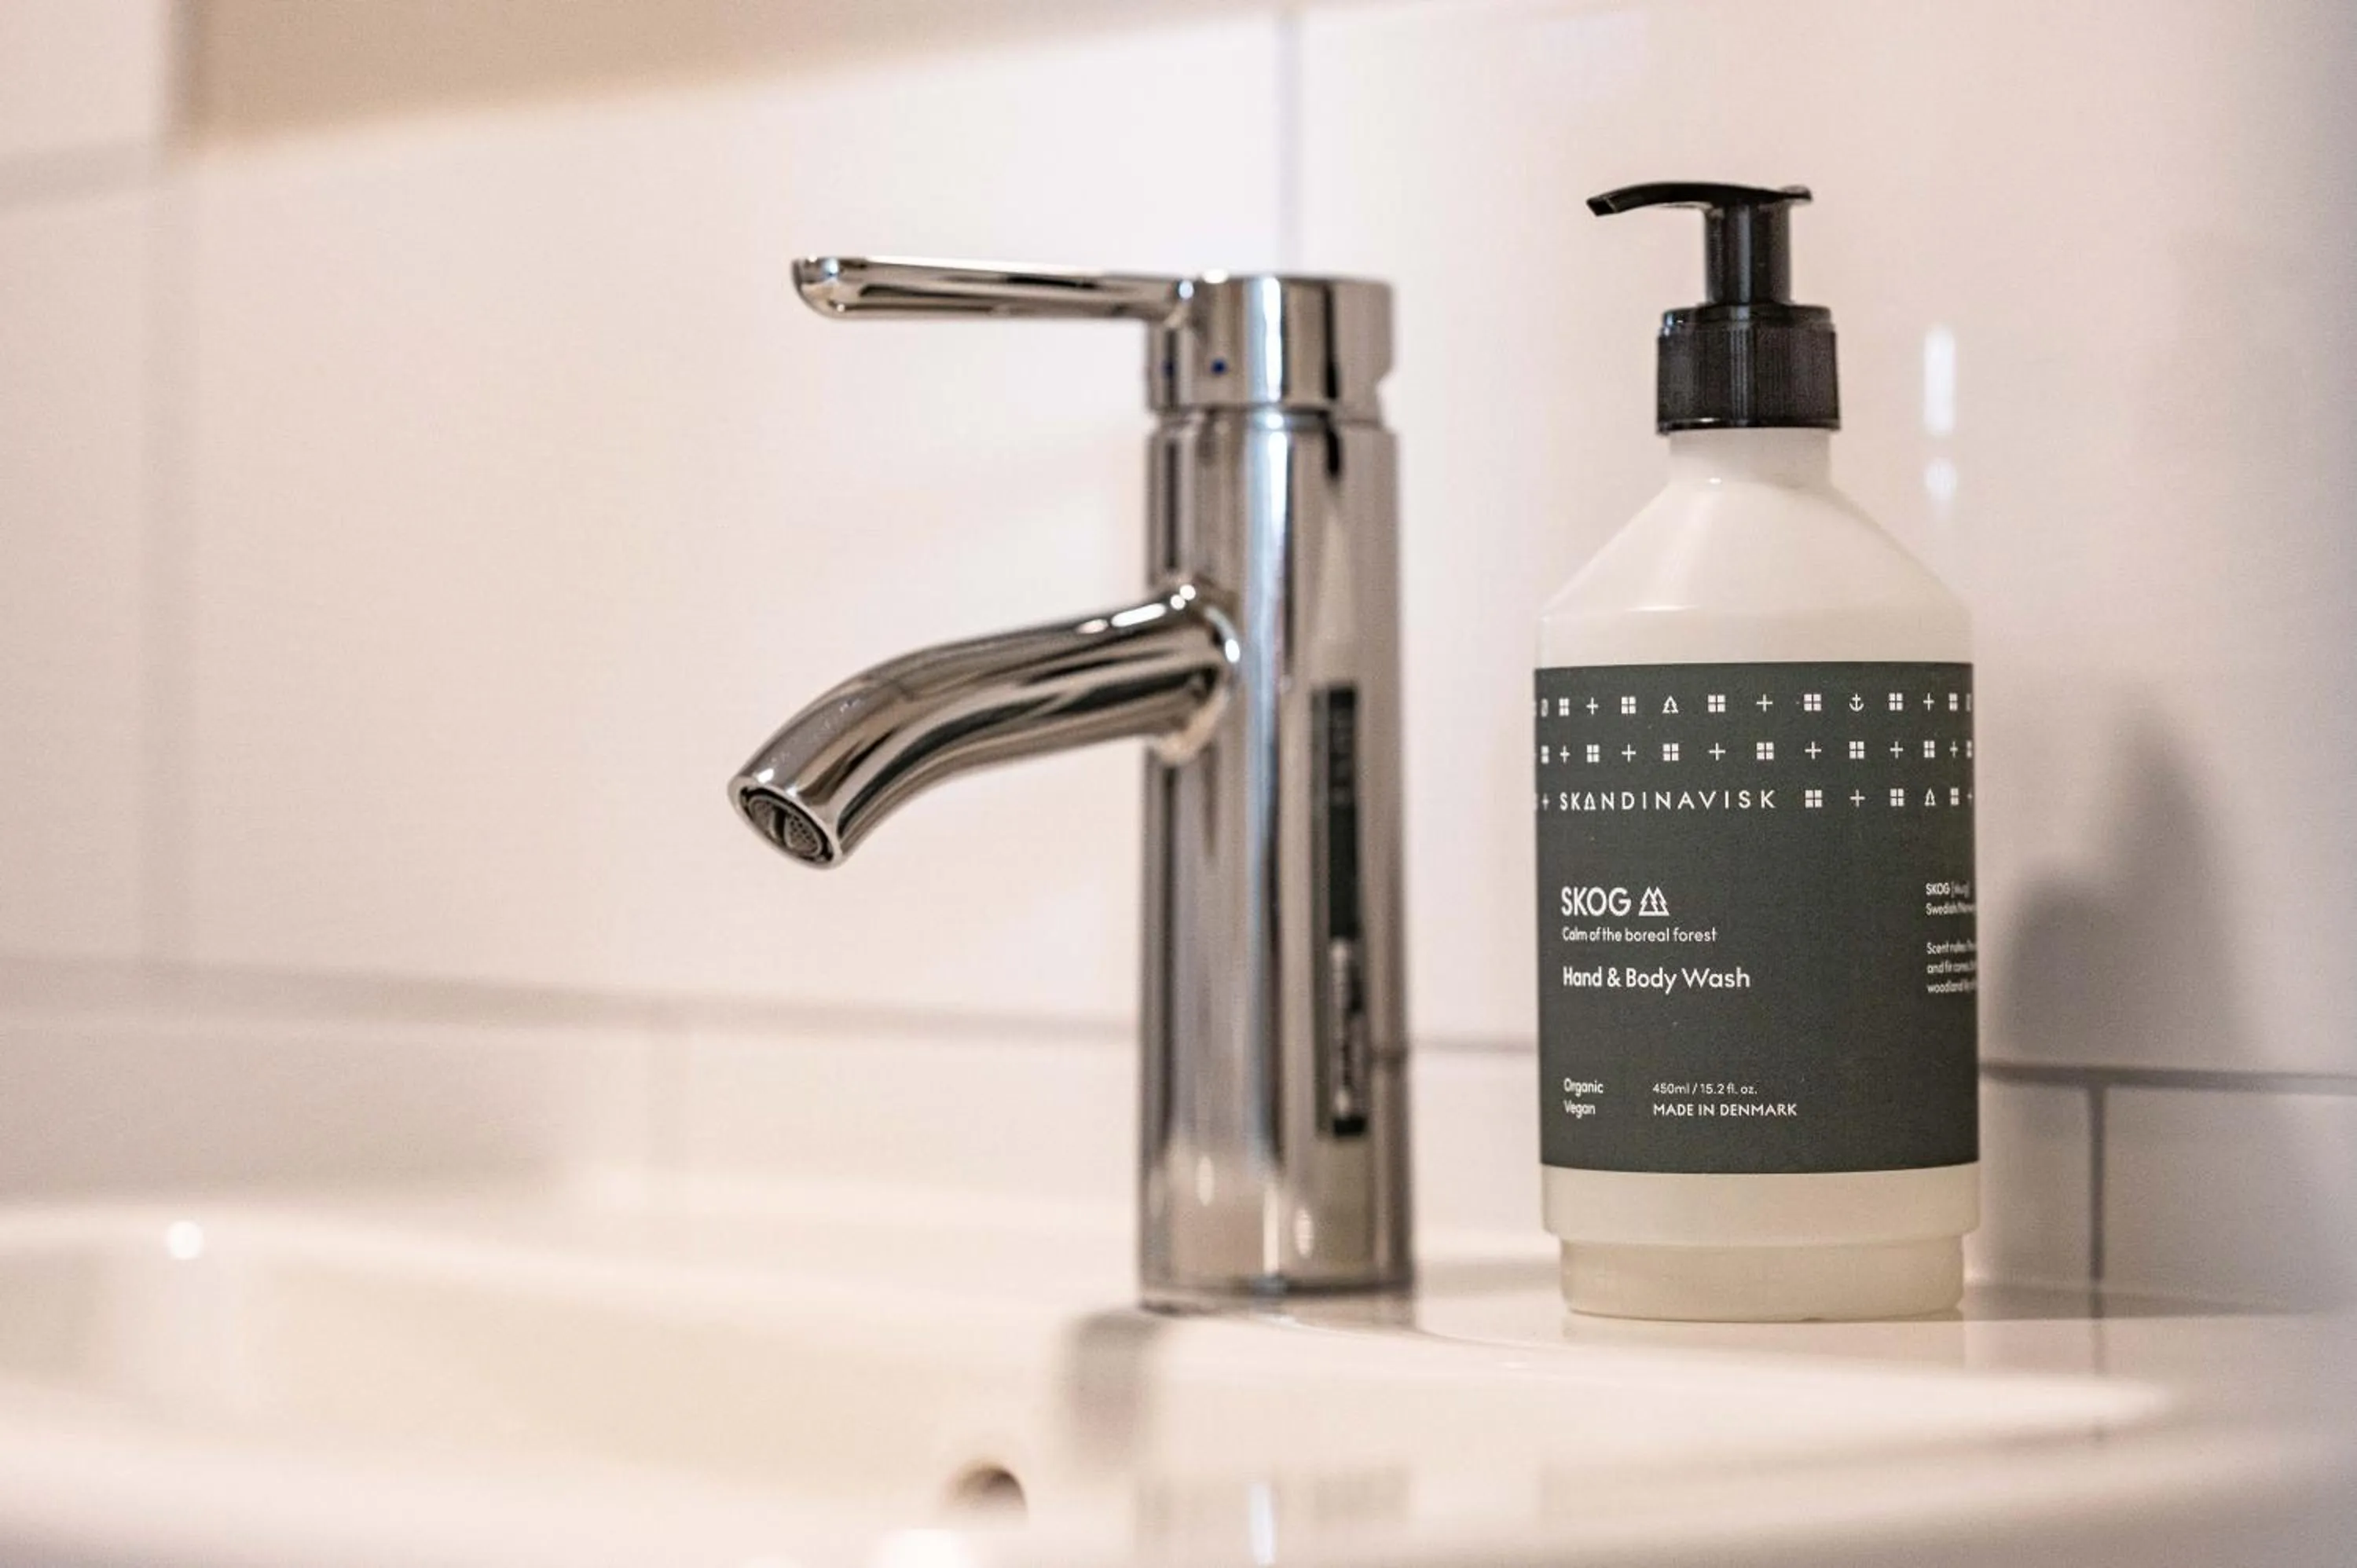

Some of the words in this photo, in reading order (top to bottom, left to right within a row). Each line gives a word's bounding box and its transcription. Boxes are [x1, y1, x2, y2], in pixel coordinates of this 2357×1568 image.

[1559, 789, 1776, 811] SKANDINAVISK
[1926, 882, 1951, 896] SKOG
[1560, 886, 1632, 917] SKOG
[1562, 926, 1588, 941] Calm
[1589, 927, 1600, 941] of
[1602, 926, 1622, 942] the
[1624, 926, 1670, 942] boreal
[1673, 927, 1717, 942] forest
[1562, 965, 1603, 987] Hand
[1607, 967, 1622, 987] &
[1626, 966, 1677, 995] Body
[1681, 967, 1751, 988] Wash
[1563, 1077, 1604, 1097] Organic
[1652, 1083, 1691, 1095] 450ml
[1692, 1083, 1699, 1096] /
[1700, 1083, 1725, 1095] 15.2
[1726, 1082, 1738, 1095] fl.
[1739, 1086, 1758, 1095] oz.
[1563, 1099, 1596, 1119] Vegan
[1652, 1103, 1695, 1116] MADE
[1698, 1103, 1715, 1116] IN
[1720, 1103, 1798, 1117] DENMARK
